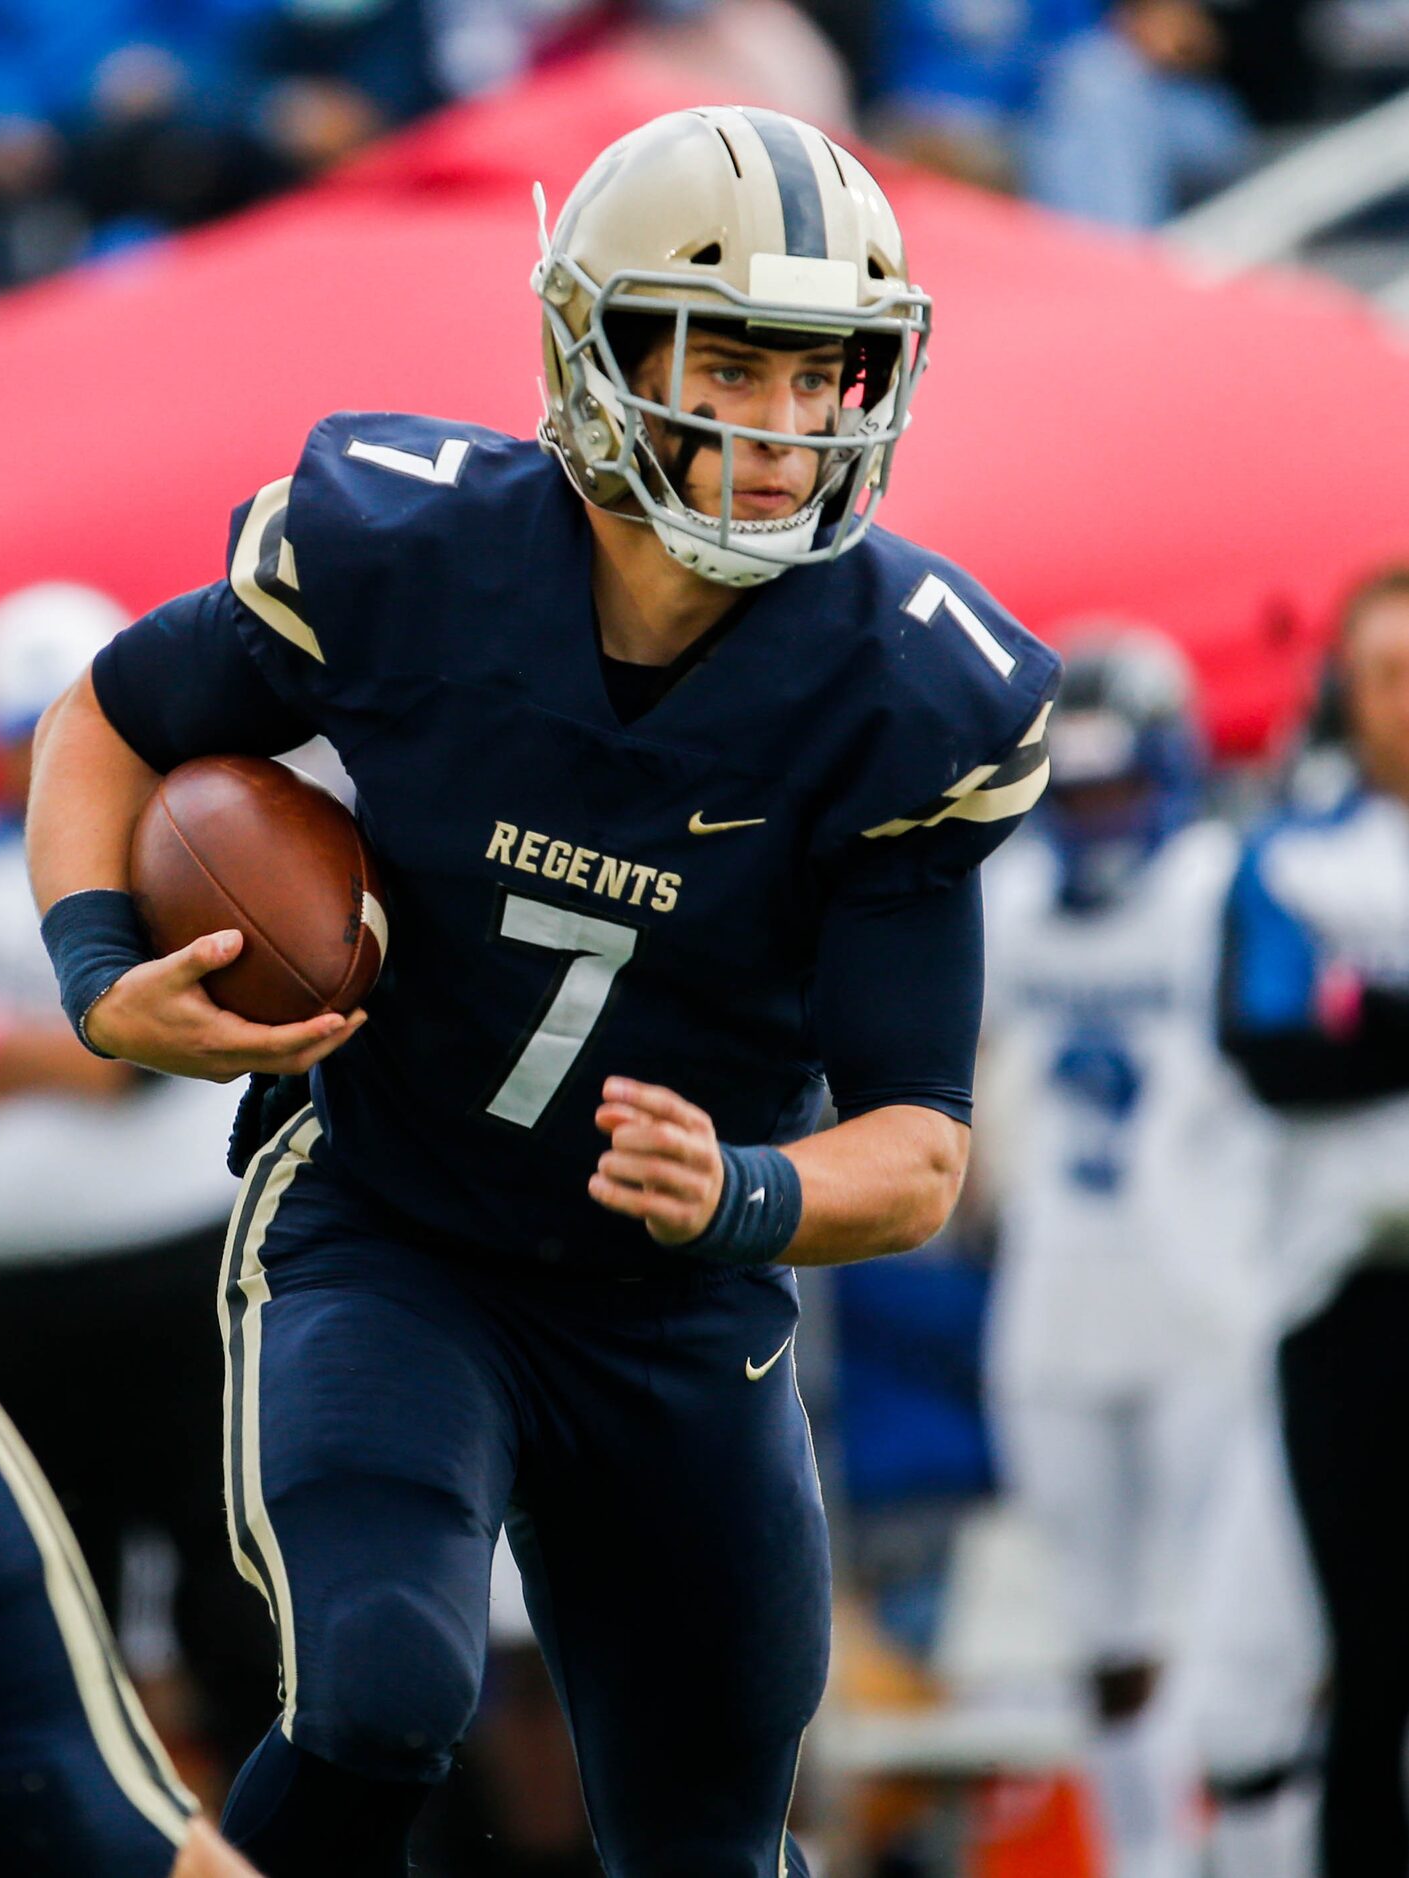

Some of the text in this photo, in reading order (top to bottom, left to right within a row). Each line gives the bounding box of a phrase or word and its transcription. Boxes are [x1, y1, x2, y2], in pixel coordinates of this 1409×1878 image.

[346, 437, 472, 486] 7
[904, 572, 1018, 681] 7
[485, 820, 683, 913] REGENTS
[485, 892, 638, 1129] 7
